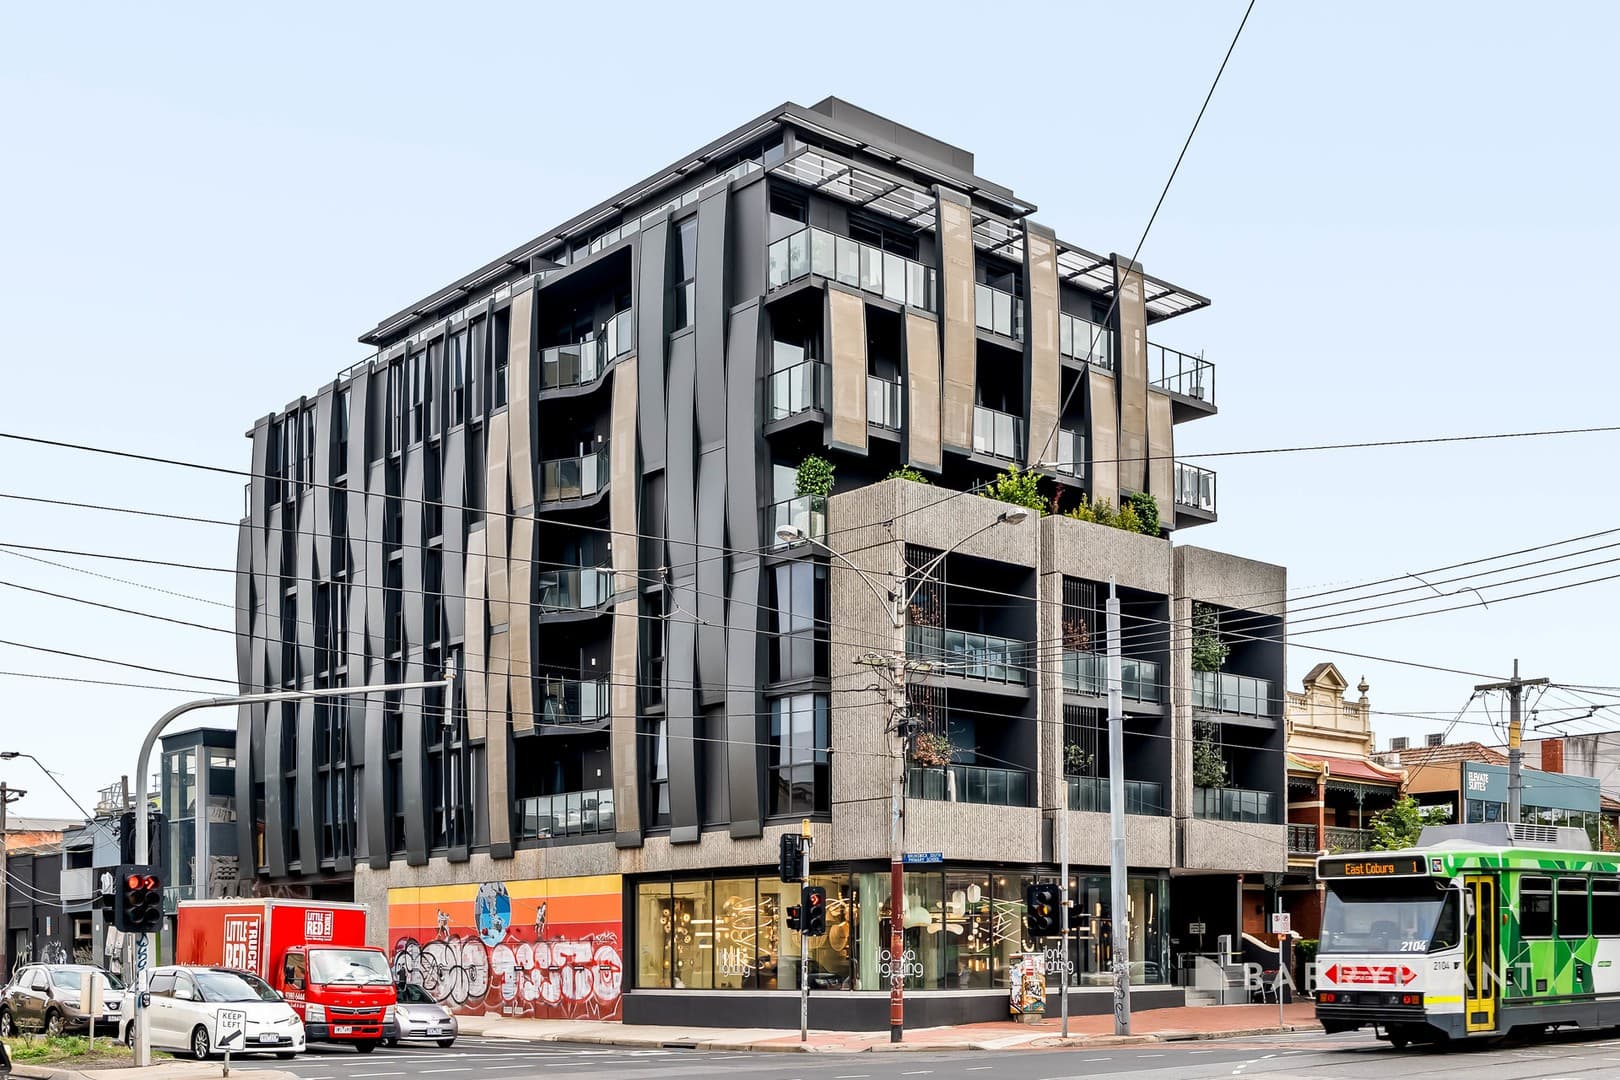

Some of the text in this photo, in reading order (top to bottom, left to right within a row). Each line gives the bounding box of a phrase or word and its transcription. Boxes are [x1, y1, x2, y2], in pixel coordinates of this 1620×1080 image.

[1468, 771, 1489, 783] ELEVATE
[1468, 781, 1487, 791] SUITES
[1345, 861, 1418, 875] East Coburg 1
[226, 921, 248, 942] LITTLE
[307, 921, 323, 935] RED
[247, 918, 259, 975] TRUCK
[1043, 945, 1064, 960] ilonk
[1400, 940, 1428, 952] 2104
[225, 943, 247, 970] RED
[875, 946, 916, 961] iloka
[875, 962, 924, 978] liging
[1433, 961, 1451, 971] 2104
[222, 1012, 242, 1020] KEEP
[222, 1021, 241, 1029] LEFT
